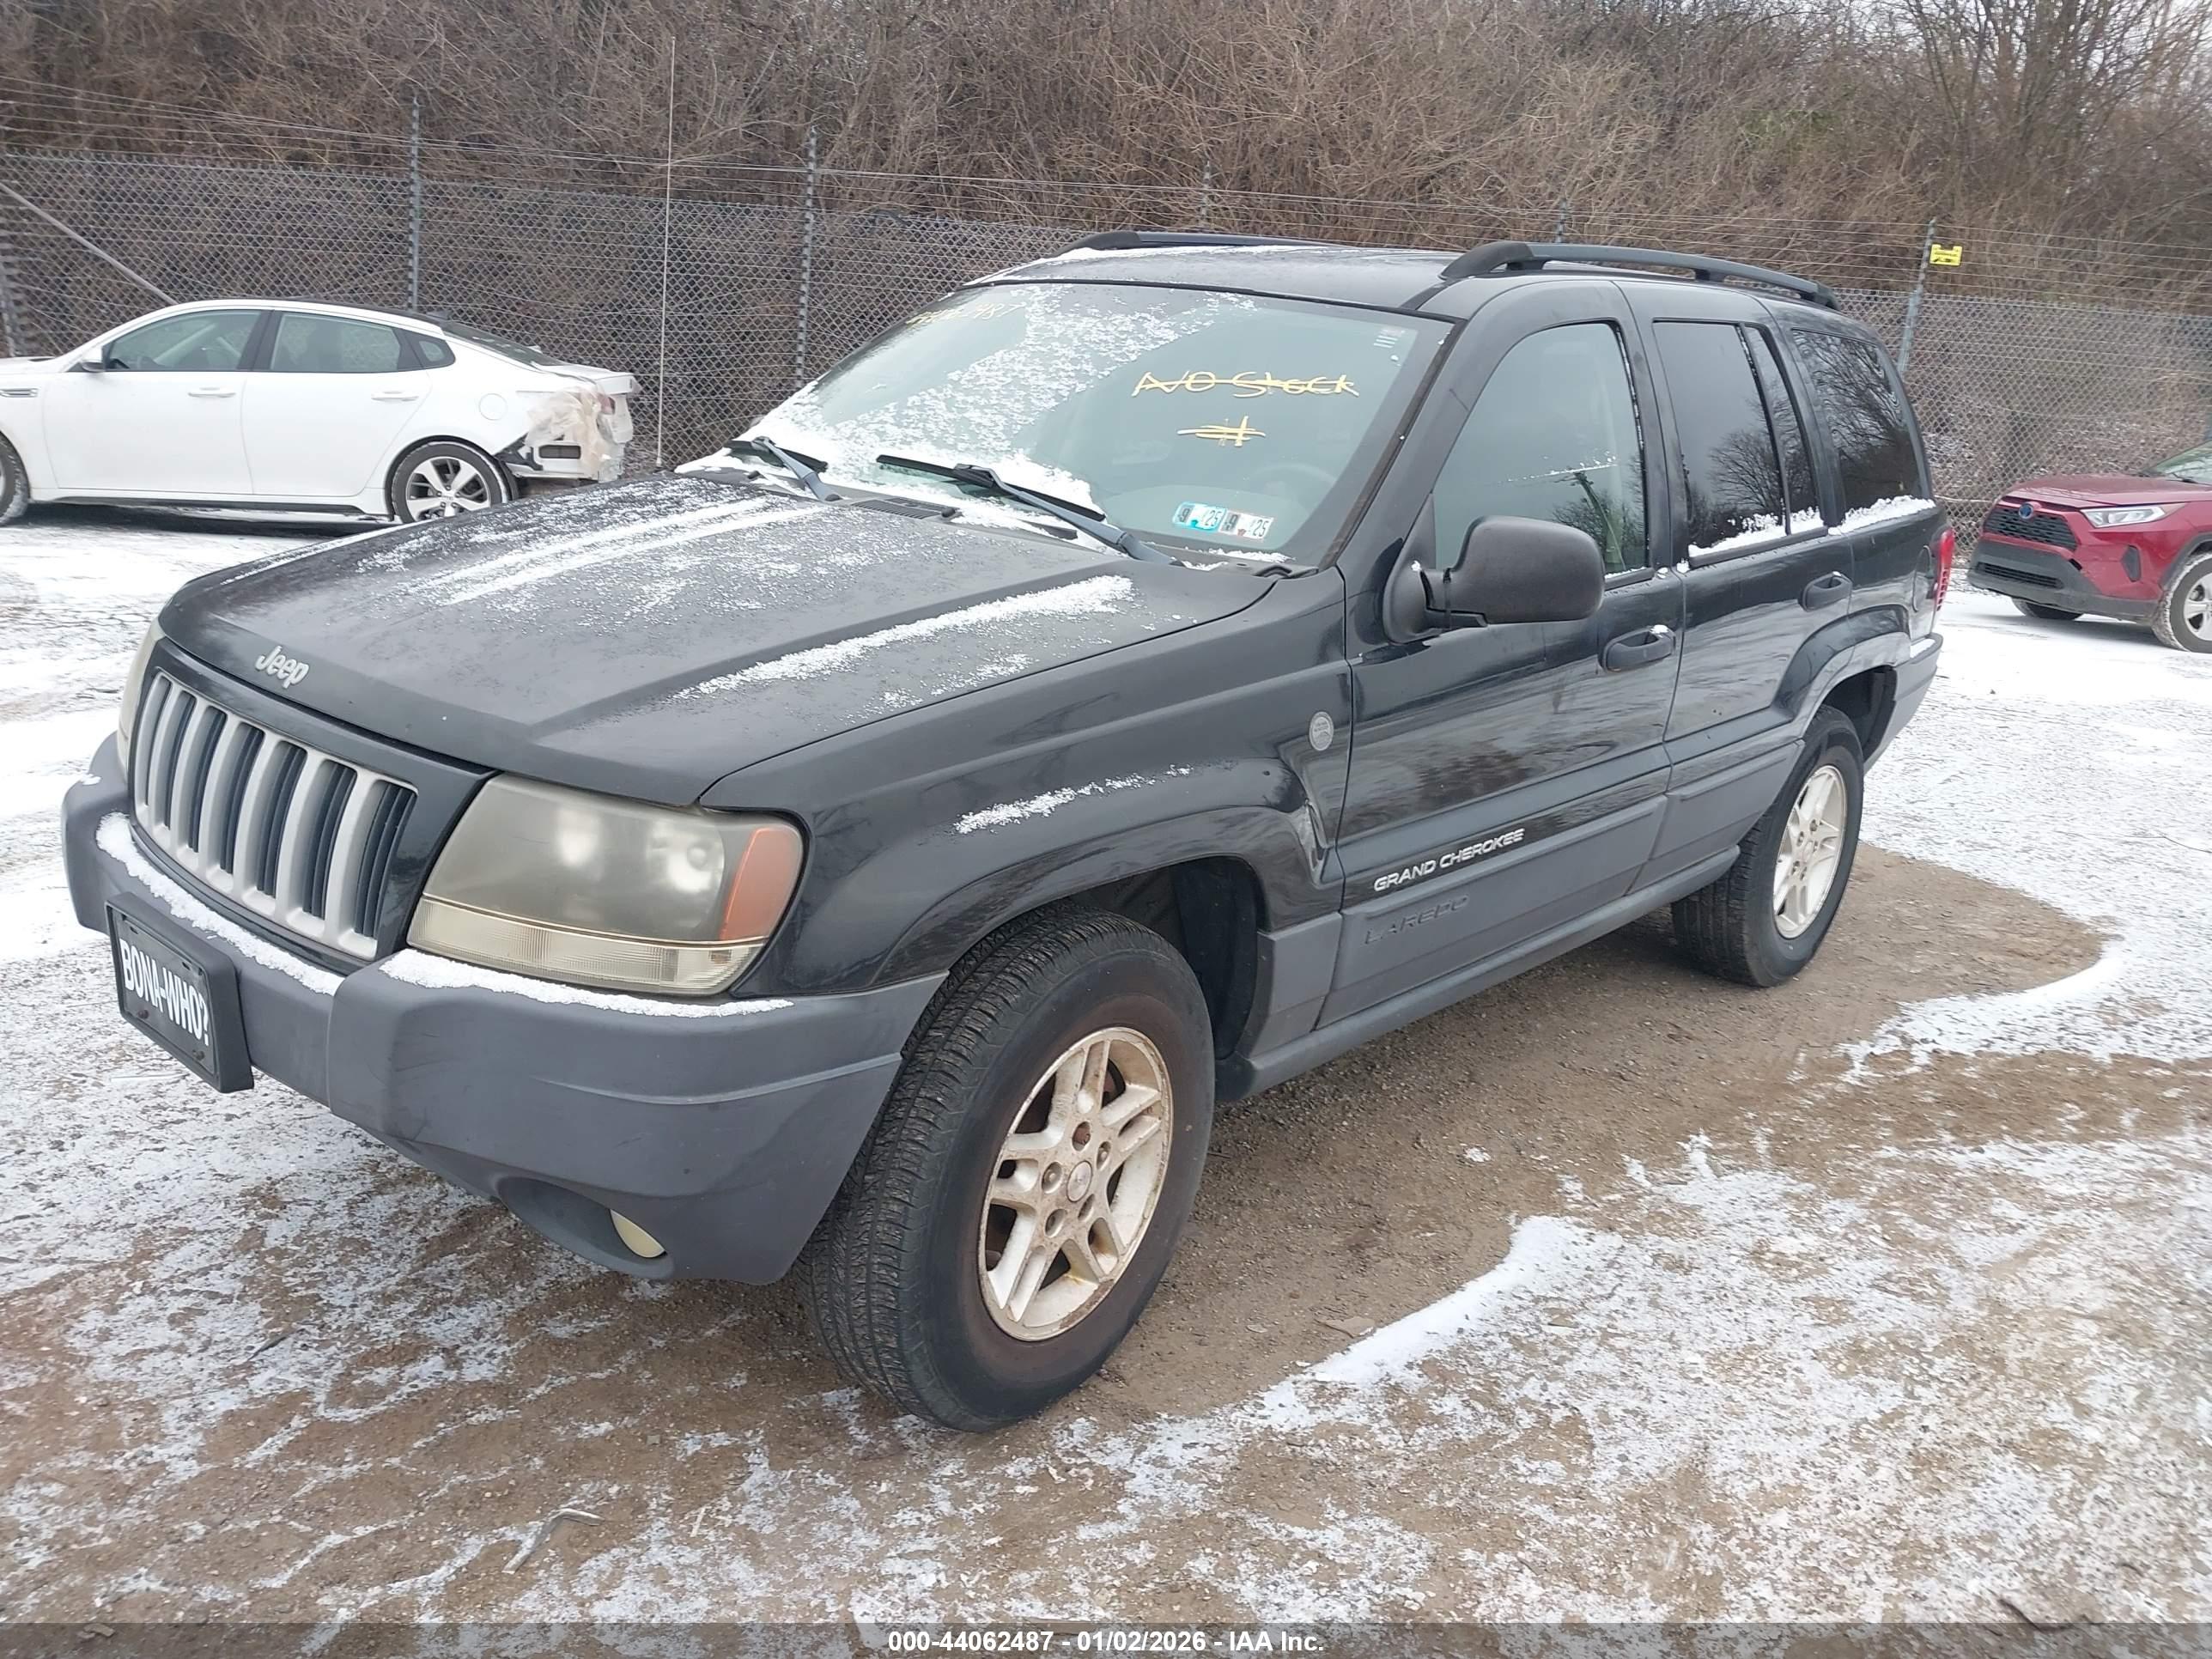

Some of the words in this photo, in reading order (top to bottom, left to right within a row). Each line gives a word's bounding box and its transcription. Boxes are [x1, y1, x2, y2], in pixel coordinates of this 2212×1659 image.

[255, 645, 309, 689] Jeep
[1374, 860, 1437, 891] GRAND
[1439, 828, 1525, 869] CHEROKEE
[1364, 894, 1470, 945] LAREDO
[119, 938, 209, 1046] BONA-WHO?
